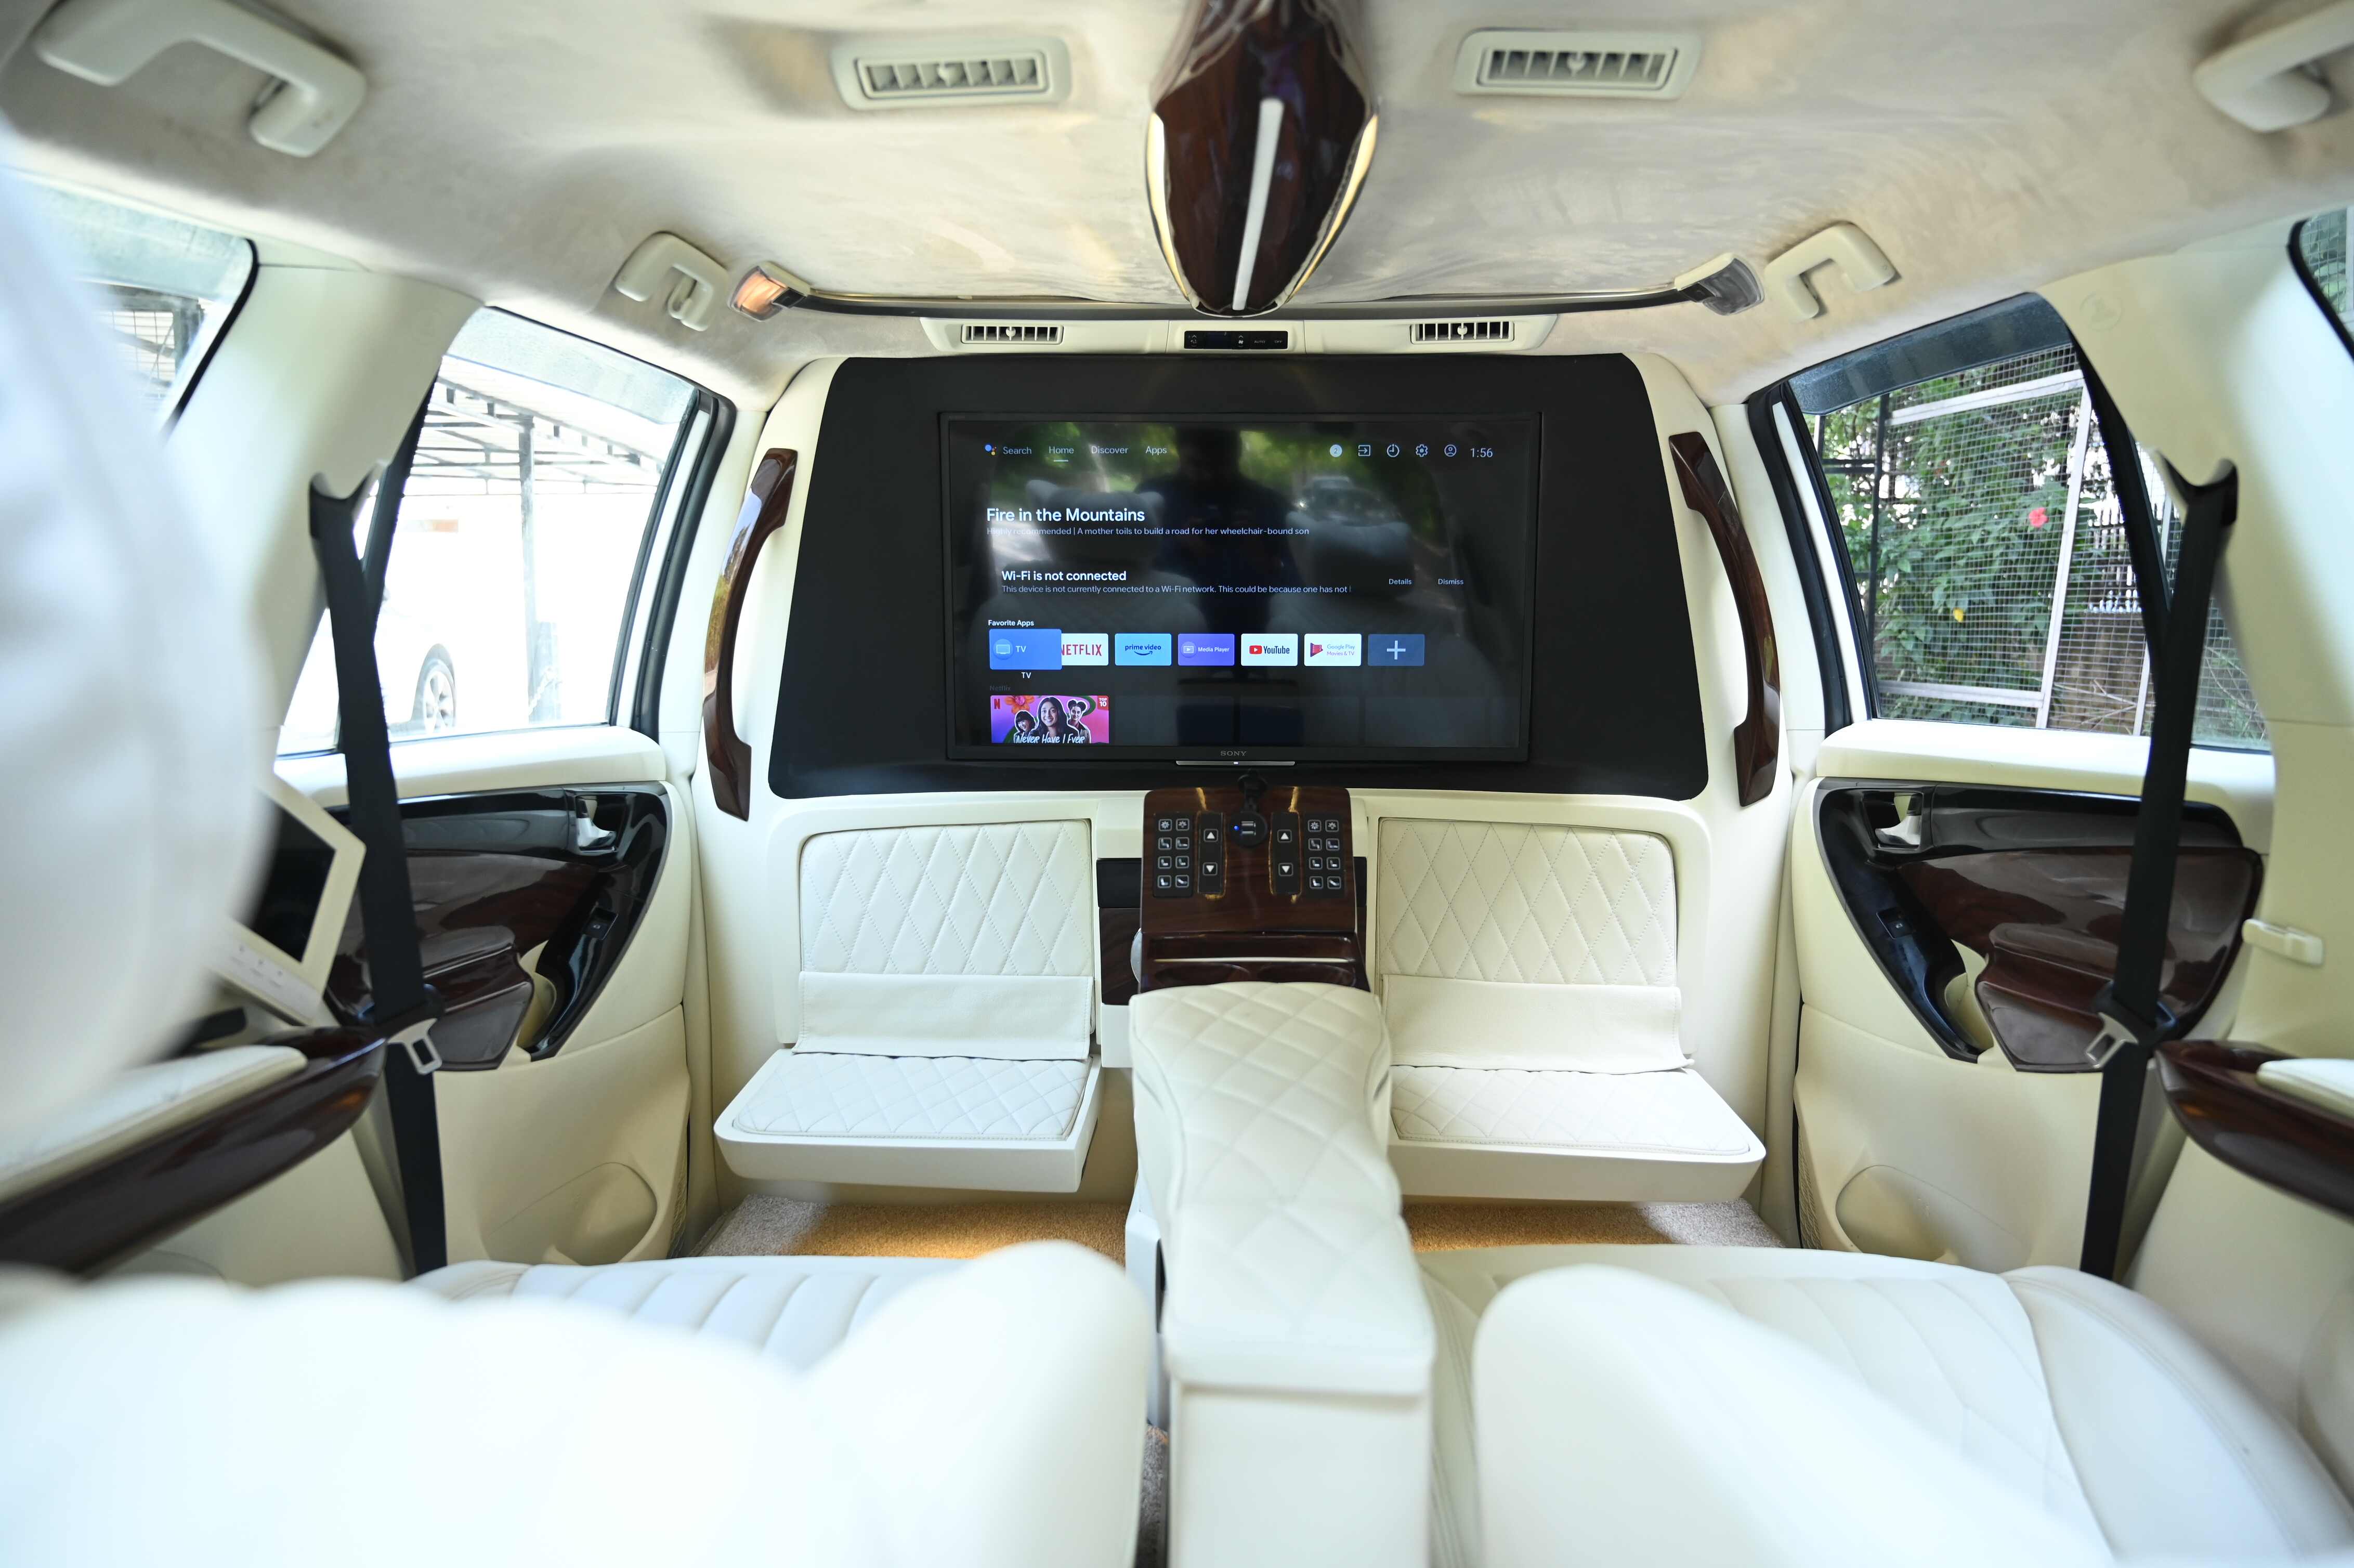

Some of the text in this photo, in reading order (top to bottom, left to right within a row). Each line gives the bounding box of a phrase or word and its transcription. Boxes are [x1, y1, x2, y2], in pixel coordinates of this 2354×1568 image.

[1145, 446, 1167, 455] Apps
[1470, 448, 1493, 458] 1:56
[987, 508, 1145, 521] Fire in the Mountains
[1002, 571, 1127, 581] Wi-Fi is not connected
[1067, 585, 1101, 594] currently
[1263, 646, 1290, 654] YouTube
